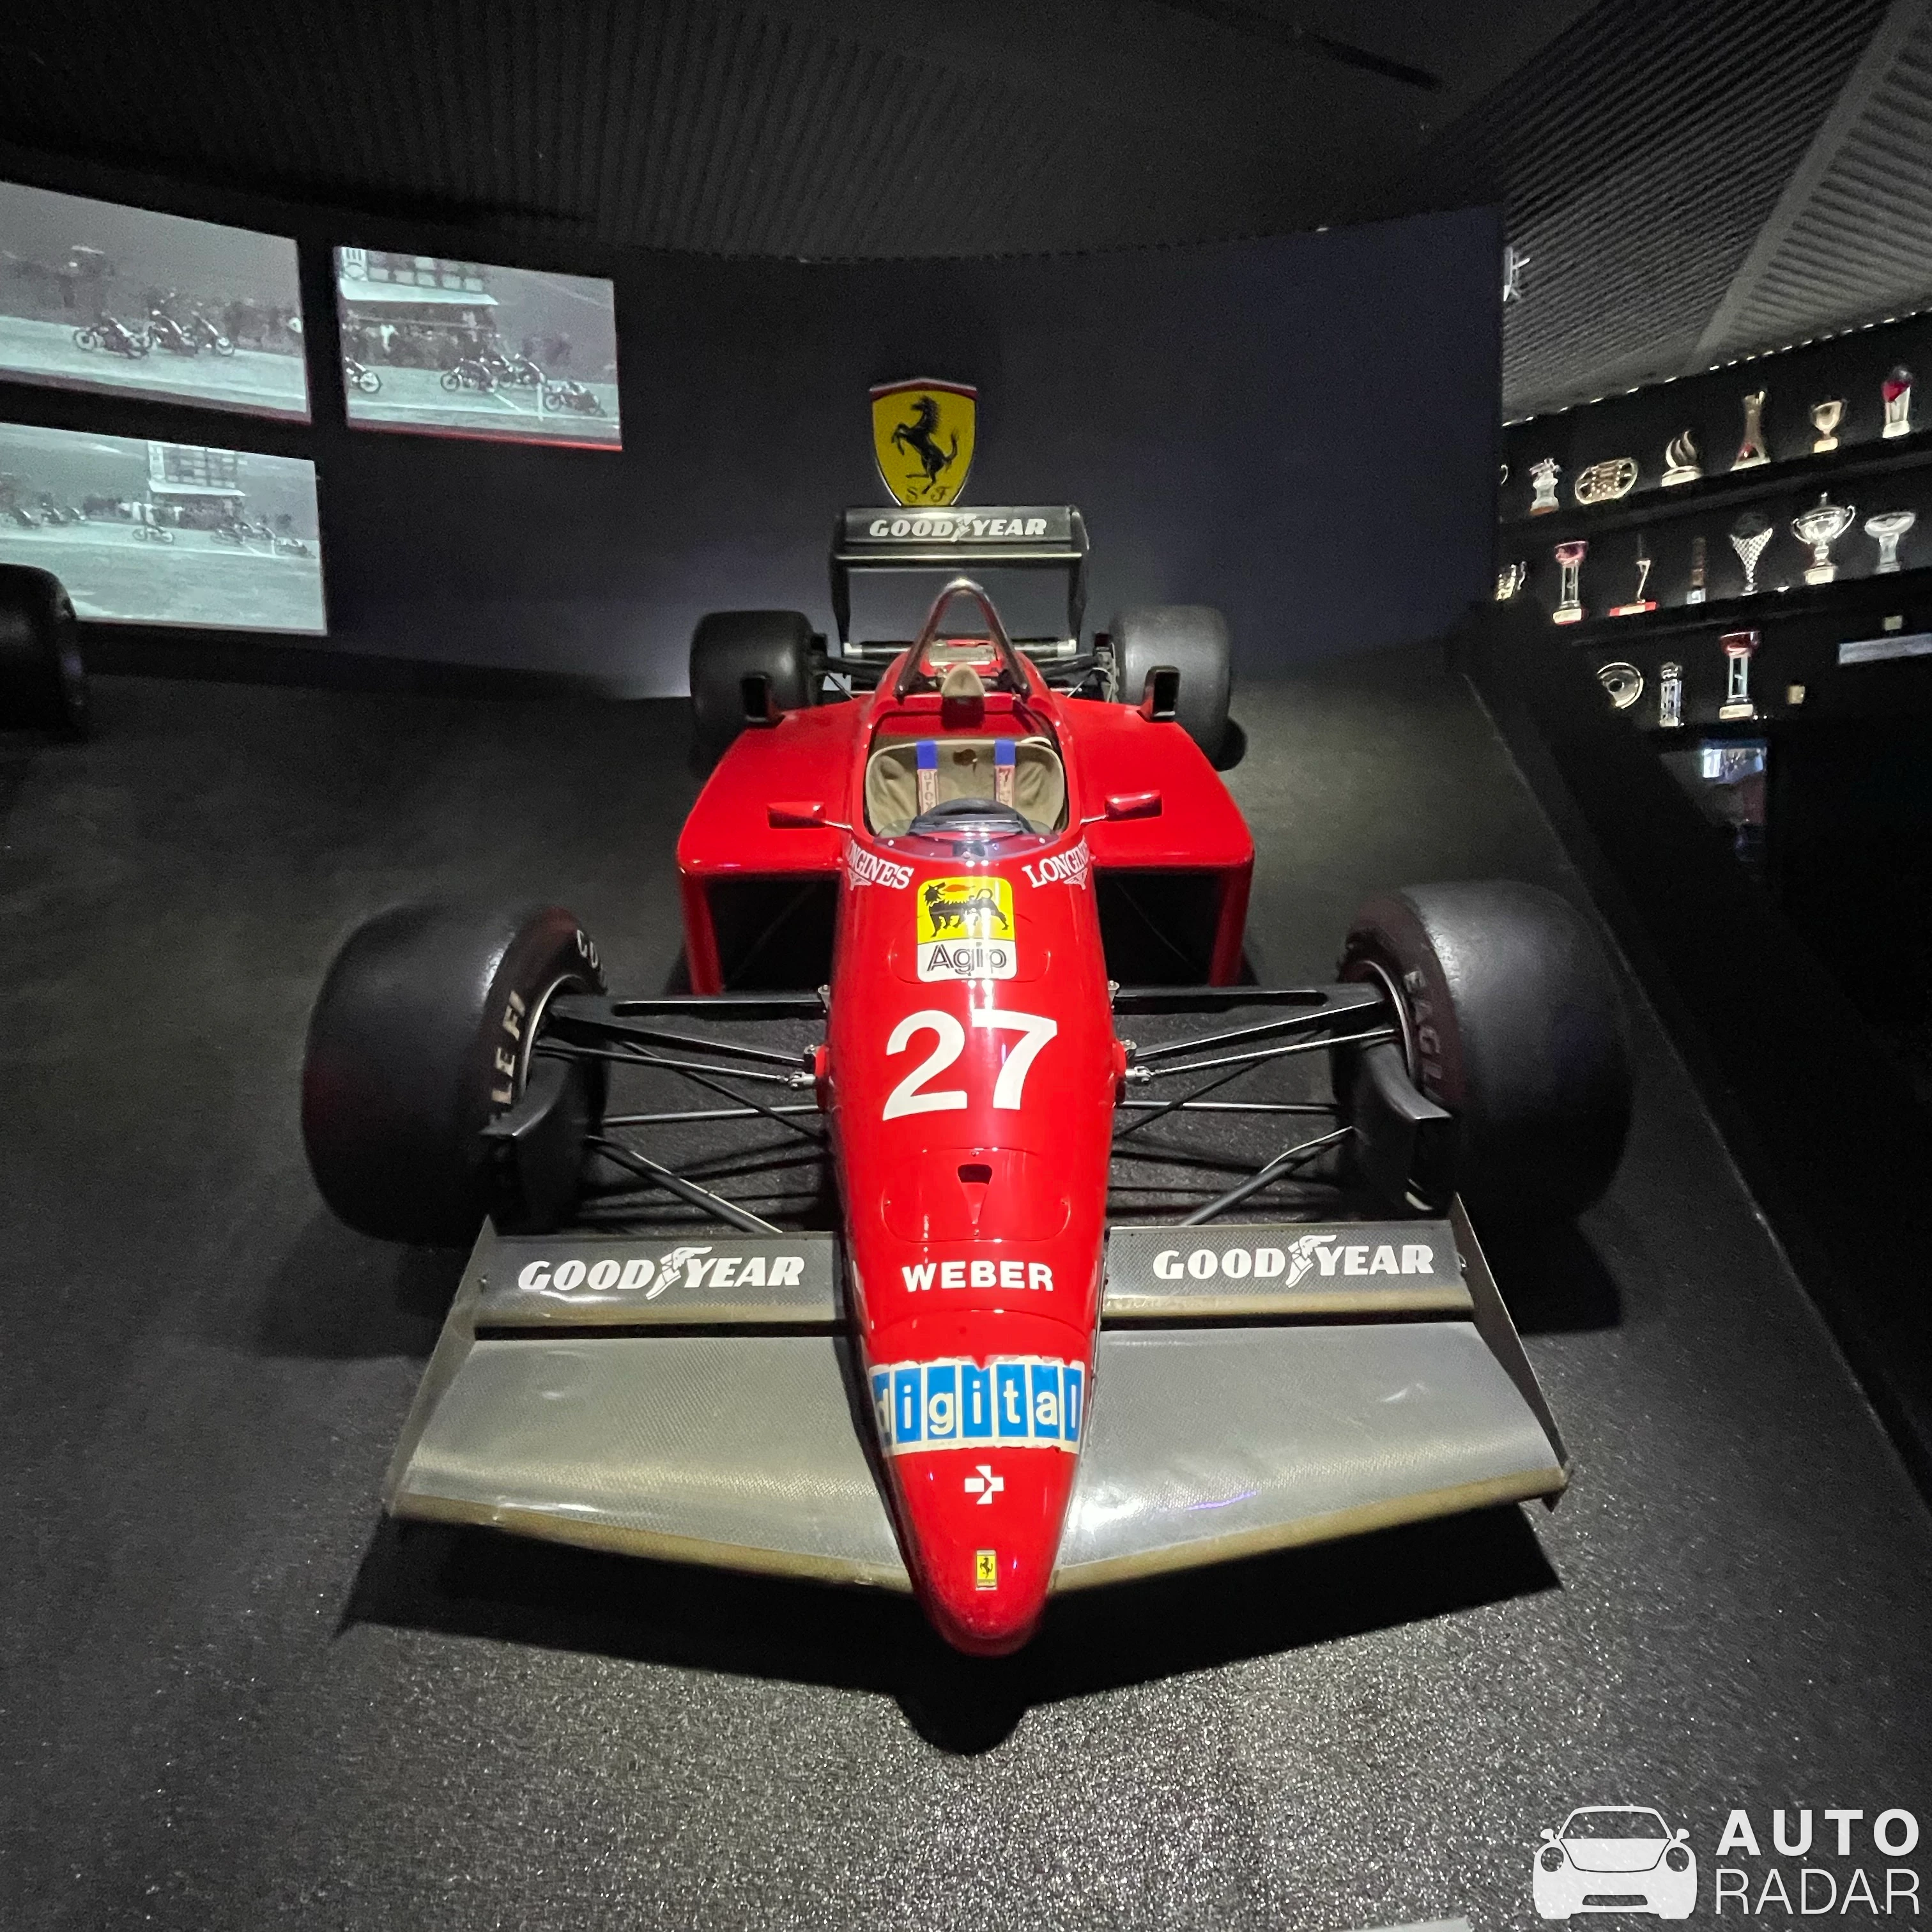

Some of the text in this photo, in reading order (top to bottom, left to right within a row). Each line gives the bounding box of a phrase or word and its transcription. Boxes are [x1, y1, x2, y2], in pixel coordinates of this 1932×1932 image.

[926, 942, 1007, 976] Agip
[882, 1008, 1057, 1121] 27
[901, 1261, 1054, 1292] WEBER
[876, 1379, 1077, 1436] digital
